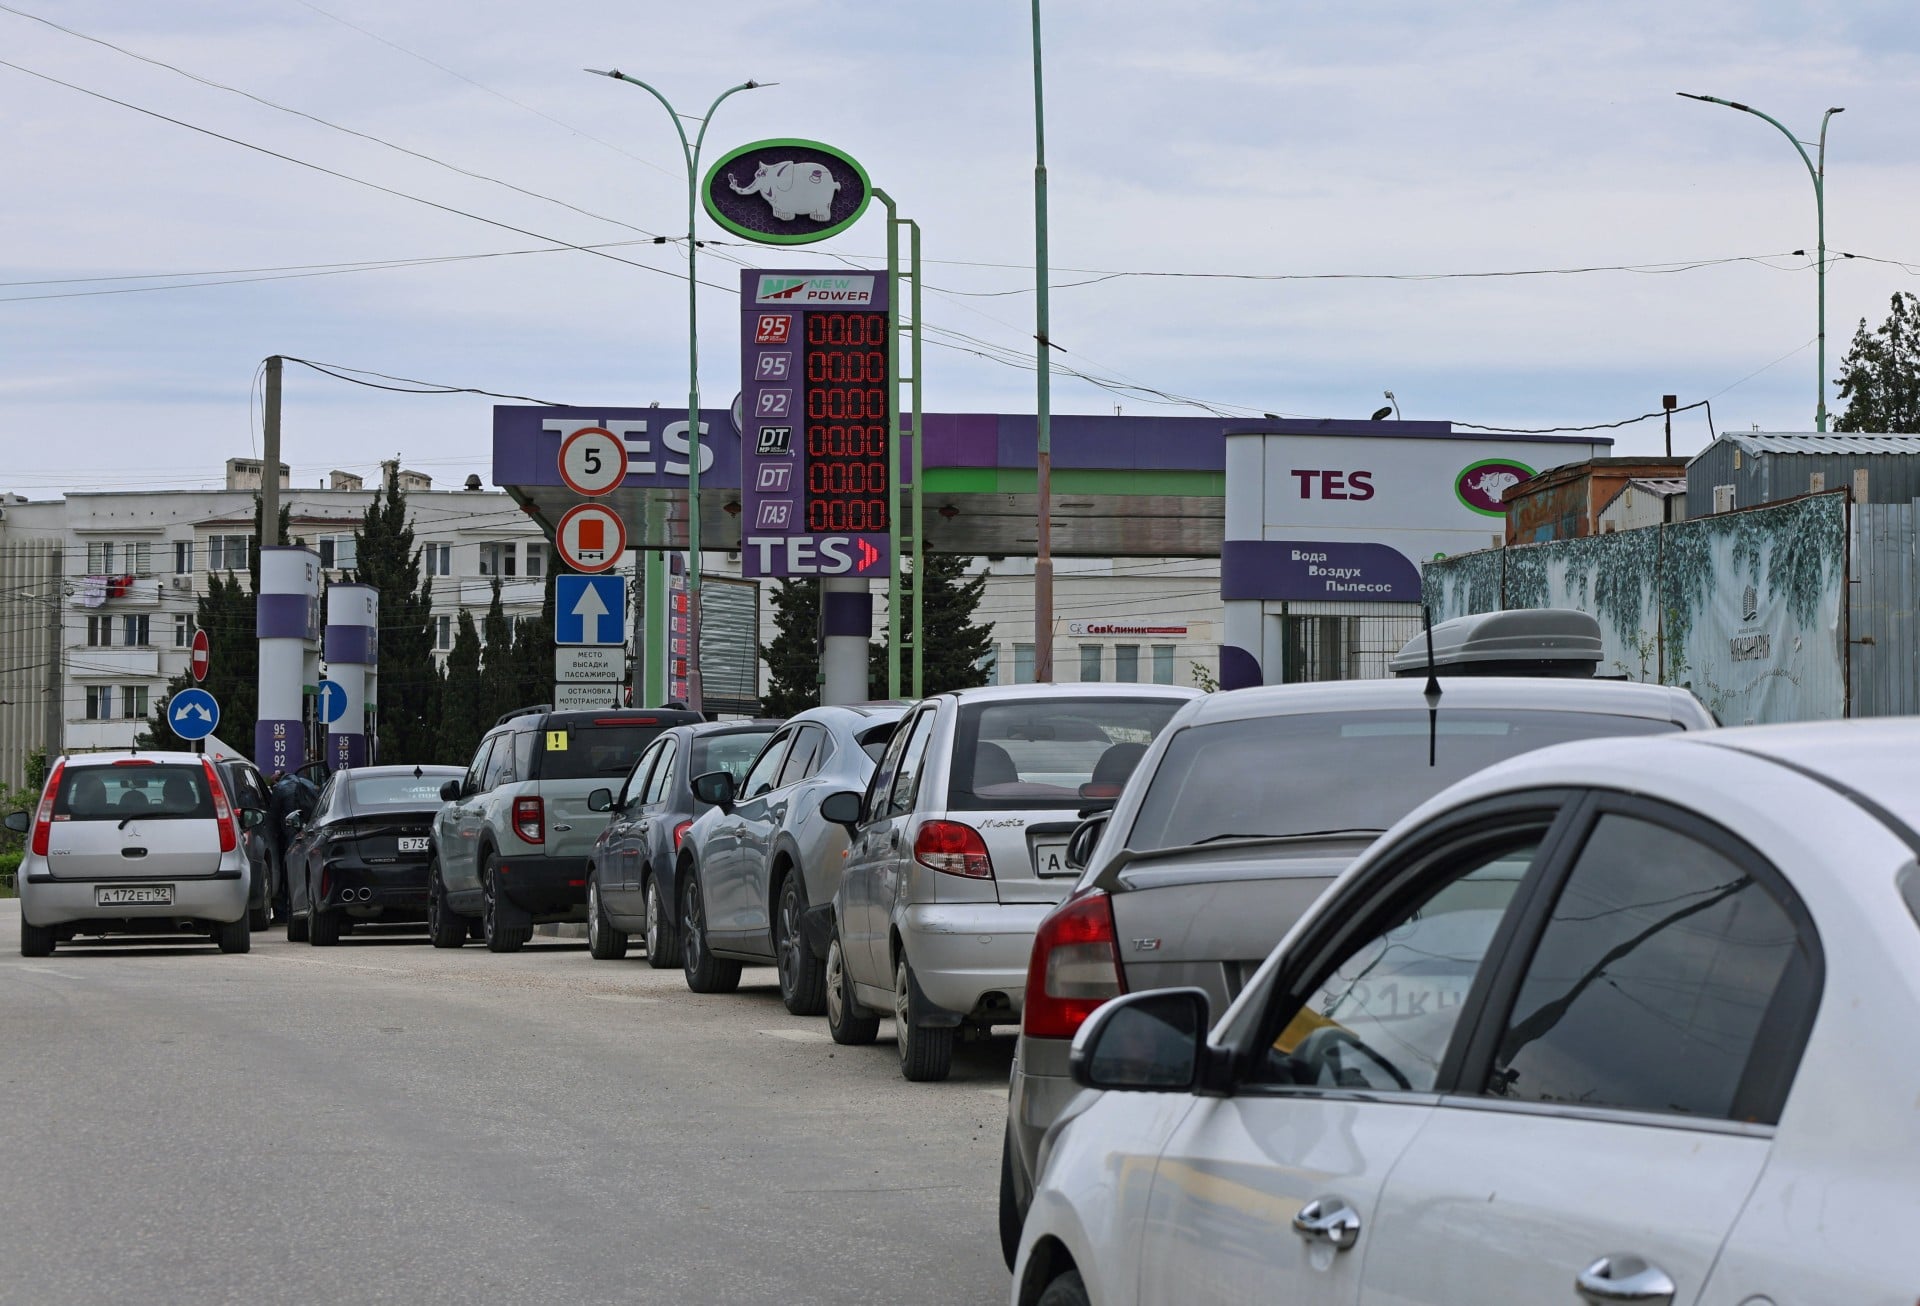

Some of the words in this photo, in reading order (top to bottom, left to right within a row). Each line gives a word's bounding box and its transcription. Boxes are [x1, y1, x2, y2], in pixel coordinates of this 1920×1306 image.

[809, 279, 851, 289] NEW
[807, 290, 869, 301] POWER
[761, 317, 787, 336] 95
[761, 357, 786, 375] 95
[761, 394, 787, 412] 92
[760, 428, 789, 447] DT
[584, 448, 601, 474] 5
[760, 469, 789, 487] DT
[1290, 469, 1375, 501] TES
[762, 505, 787, 524] ГАЗ
[747, 536, 852, 574] TES
[1291, 550, 1327, 563] Вода
[1308, 565, 1361, 578] Воздух
[1325, 580, 1392, 593] Пылесос
[572, 661, 609, 669] ВЫСАДКИ
[273, 723, 286, 735] 95
[274, 740, 286, 752] 95
[338, 736, 349, 746] 95
[274, 754, 286, 767] 92
[339, 750, 349, 760] 95
[976, 818, 1025, 830] Matiz
